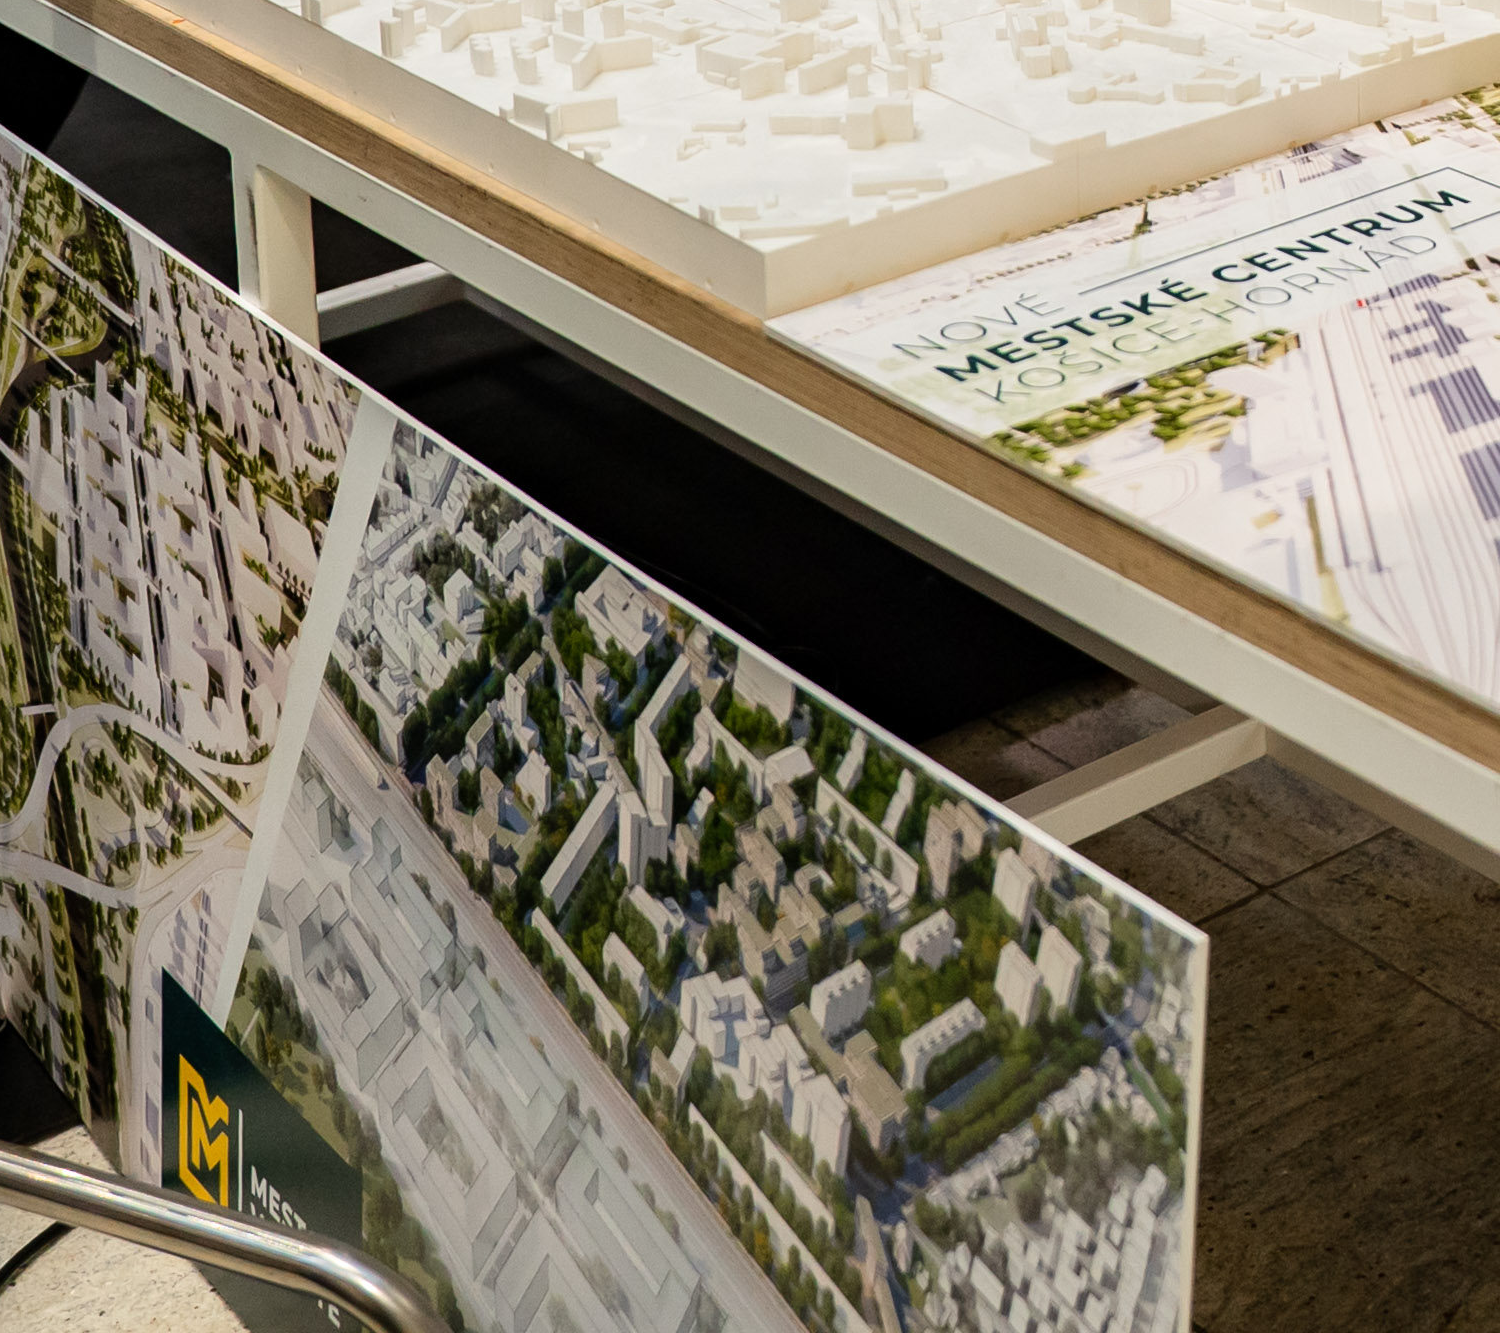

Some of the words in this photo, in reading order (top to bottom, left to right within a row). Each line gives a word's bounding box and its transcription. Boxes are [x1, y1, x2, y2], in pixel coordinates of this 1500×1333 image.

[892, 292, 1065, 360] NOVÉ
[934, 278, 1209, 383] MESTSKÉ
[1212, 190, 1472, 283] CENTRUM
[975, 235, 1437, 404] KOŠICE-HORNÁD
